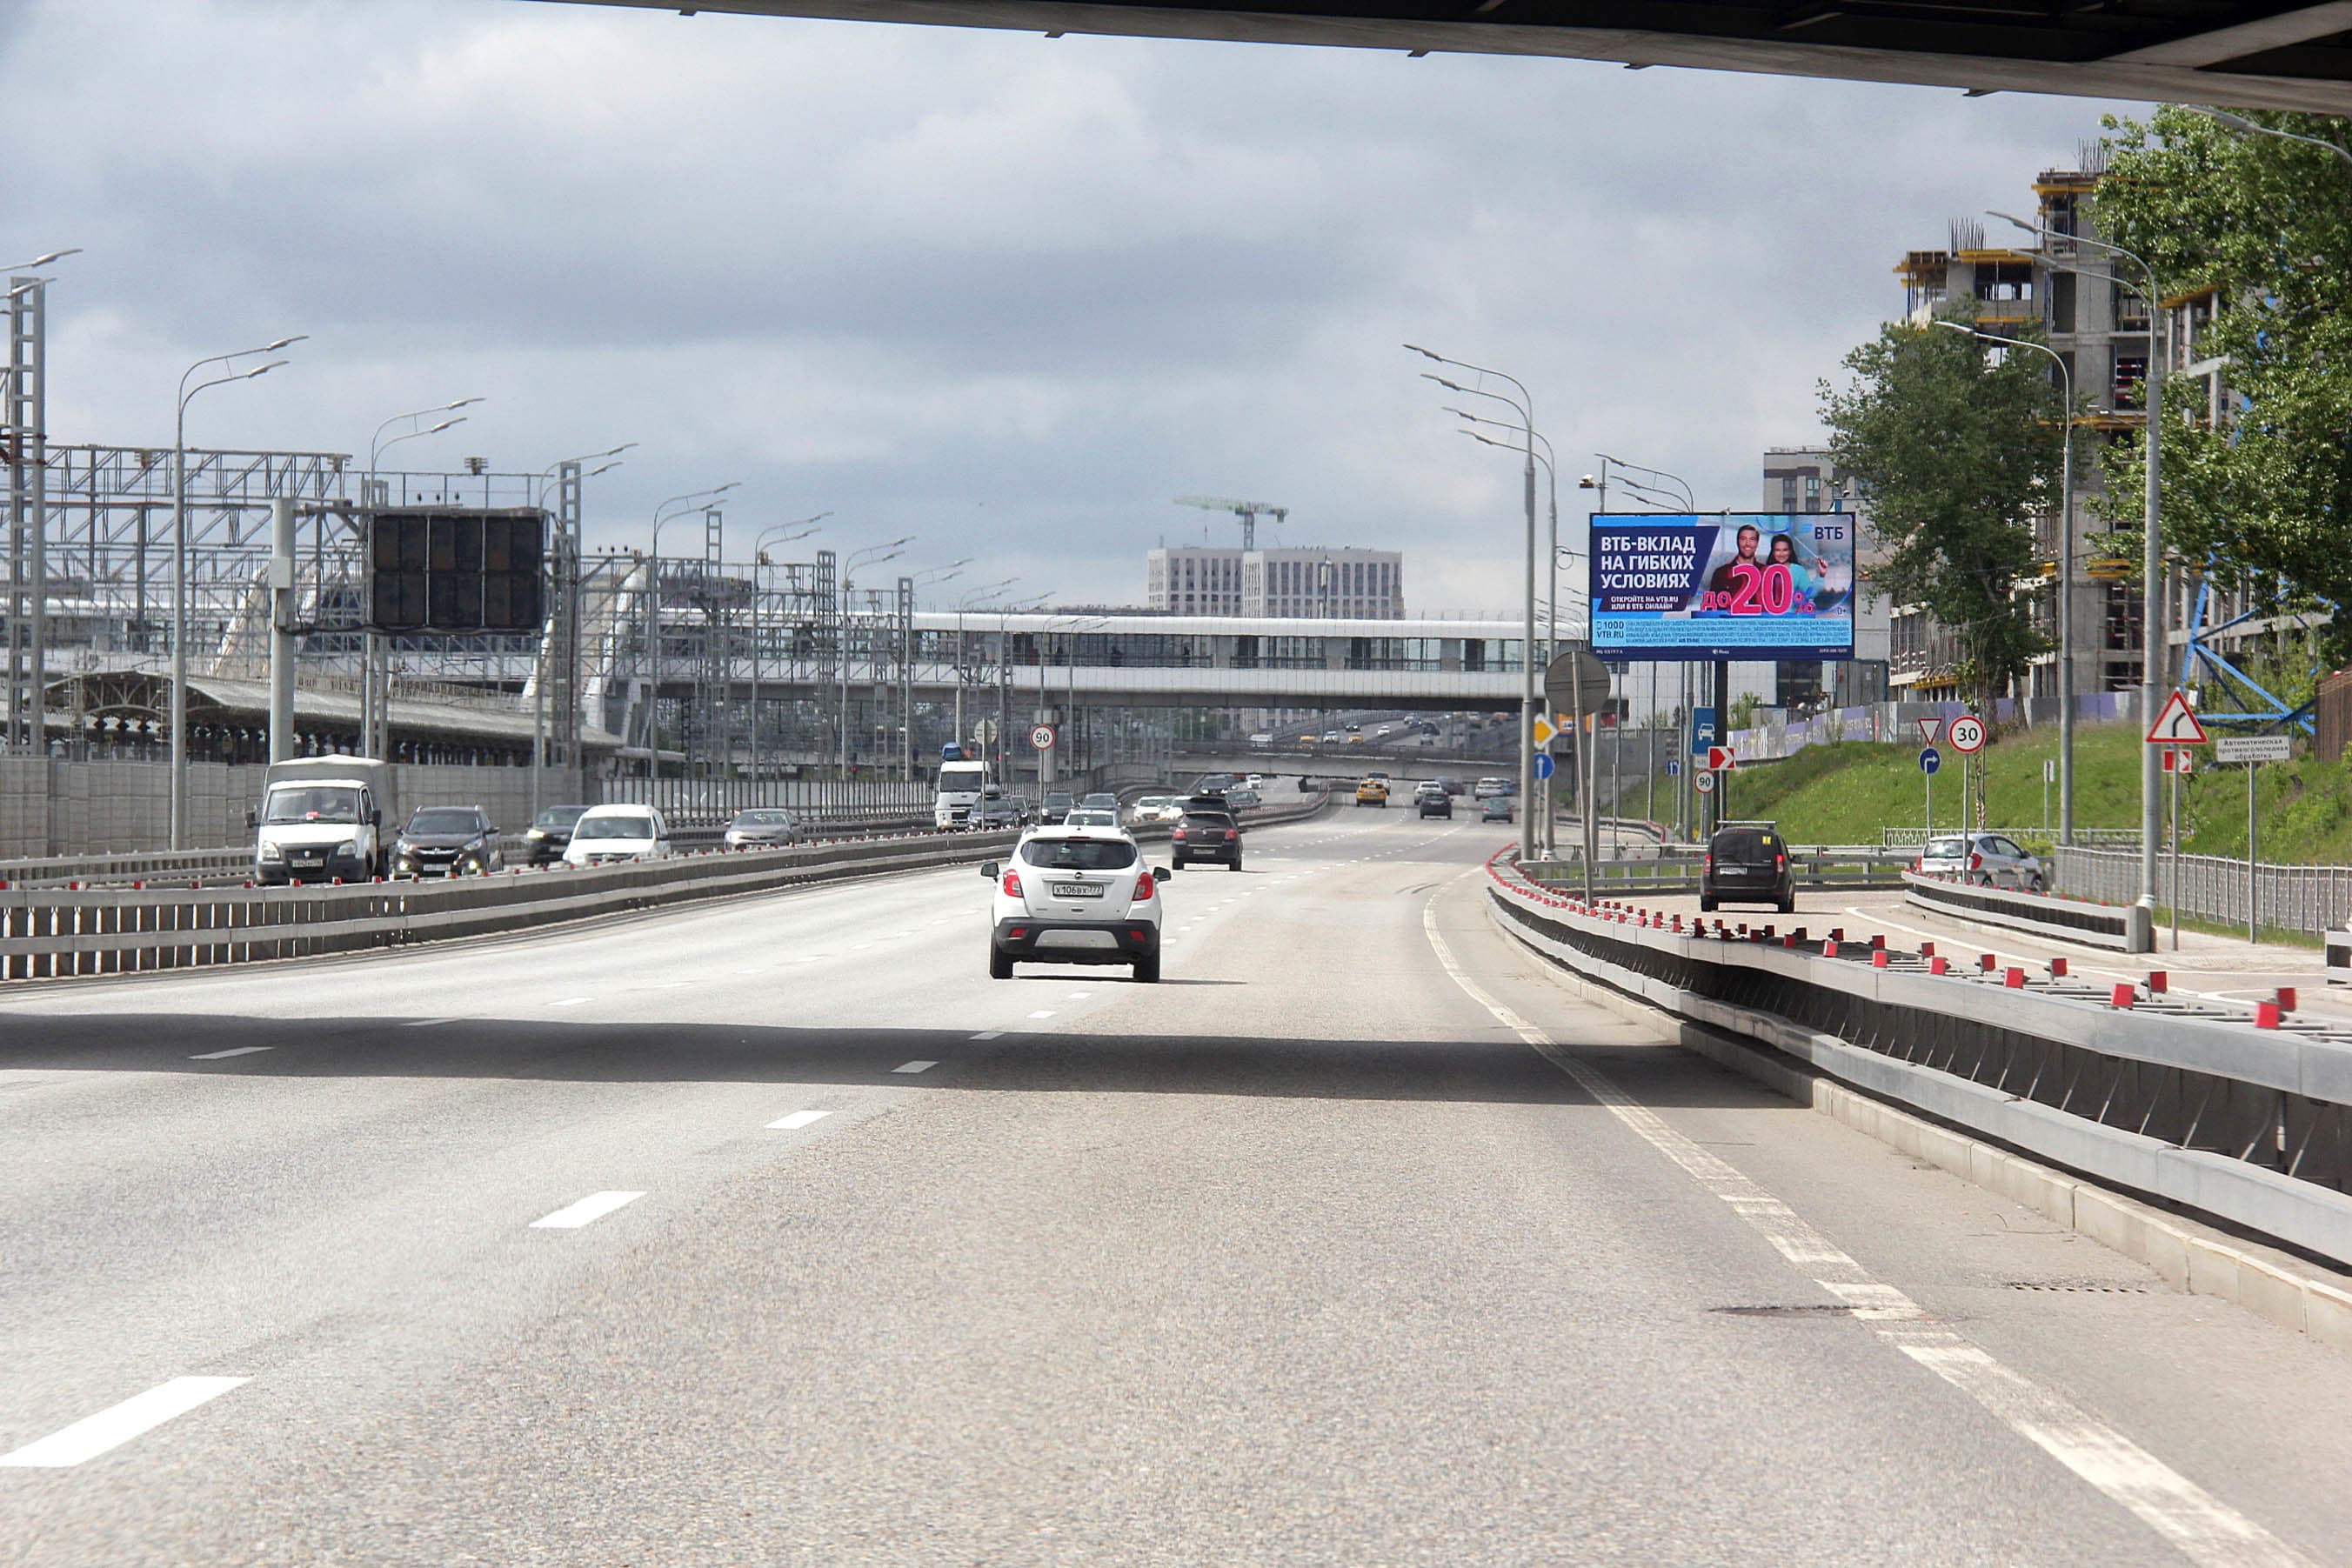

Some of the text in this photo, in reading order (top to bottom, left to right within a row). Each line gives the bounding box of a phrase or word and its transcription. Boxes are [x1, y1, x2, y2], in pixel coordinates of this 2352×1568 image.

[1814, 526, 1844, 540] ВТБ
[1600, 536, 1697, 554] ВТБ-ВКЛАД
[1600, 555, 1694, 570] НА ГИБКИХ
[1600, 573, 1690, 590] УСЛОВИЯХ
[1610, 595, 1645, 604] ОТКРОЙТЕ
[1645, 602, 1673, 611] ОНЛАЙН
[1603, 621, 1625, 630] 1000
[1596, 631, 1624, 639] VTB.RU
[1035, 732, 1050, 743] 90
[1957, 727, 1978, 742] 30
[1699, 777, 1711, 787] 90
